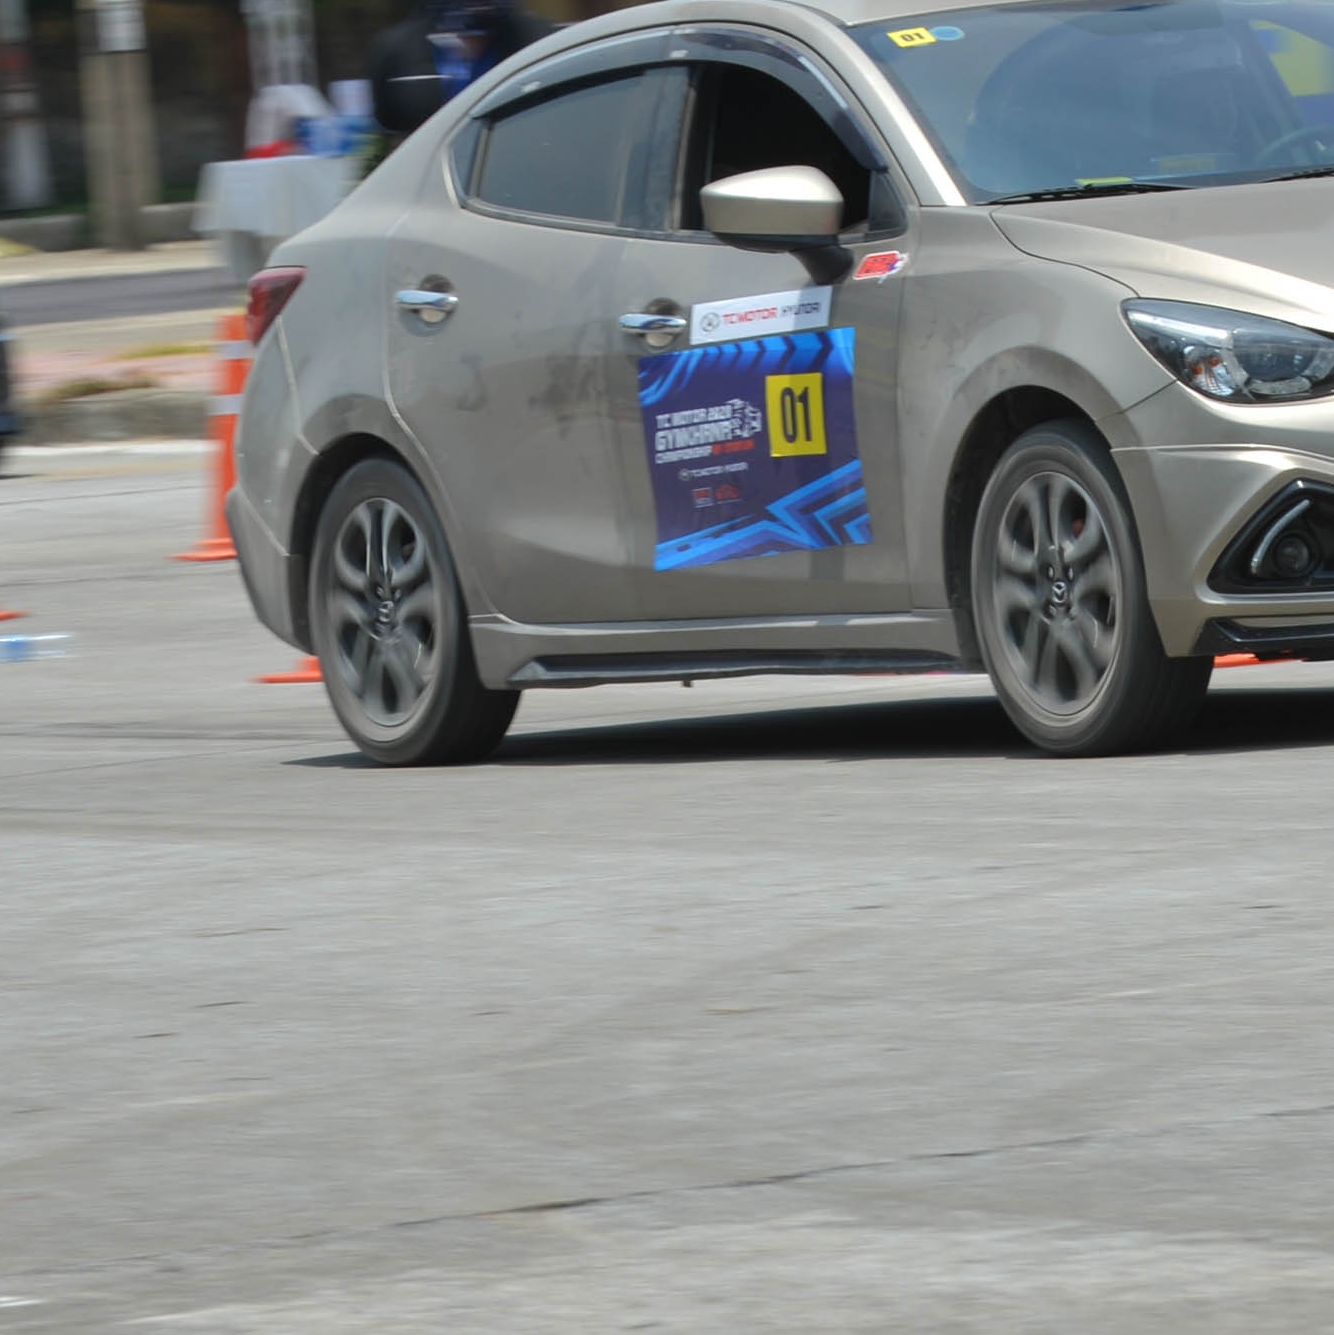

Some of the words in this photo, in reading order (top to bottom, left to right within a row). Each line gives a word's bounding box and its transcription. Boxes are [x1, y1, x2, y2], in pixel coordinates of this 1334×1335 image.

[899, 31, 926, 43] 01
[738, 306, 779, 323] MOTOR
[780, 385, 813, 444] 01
